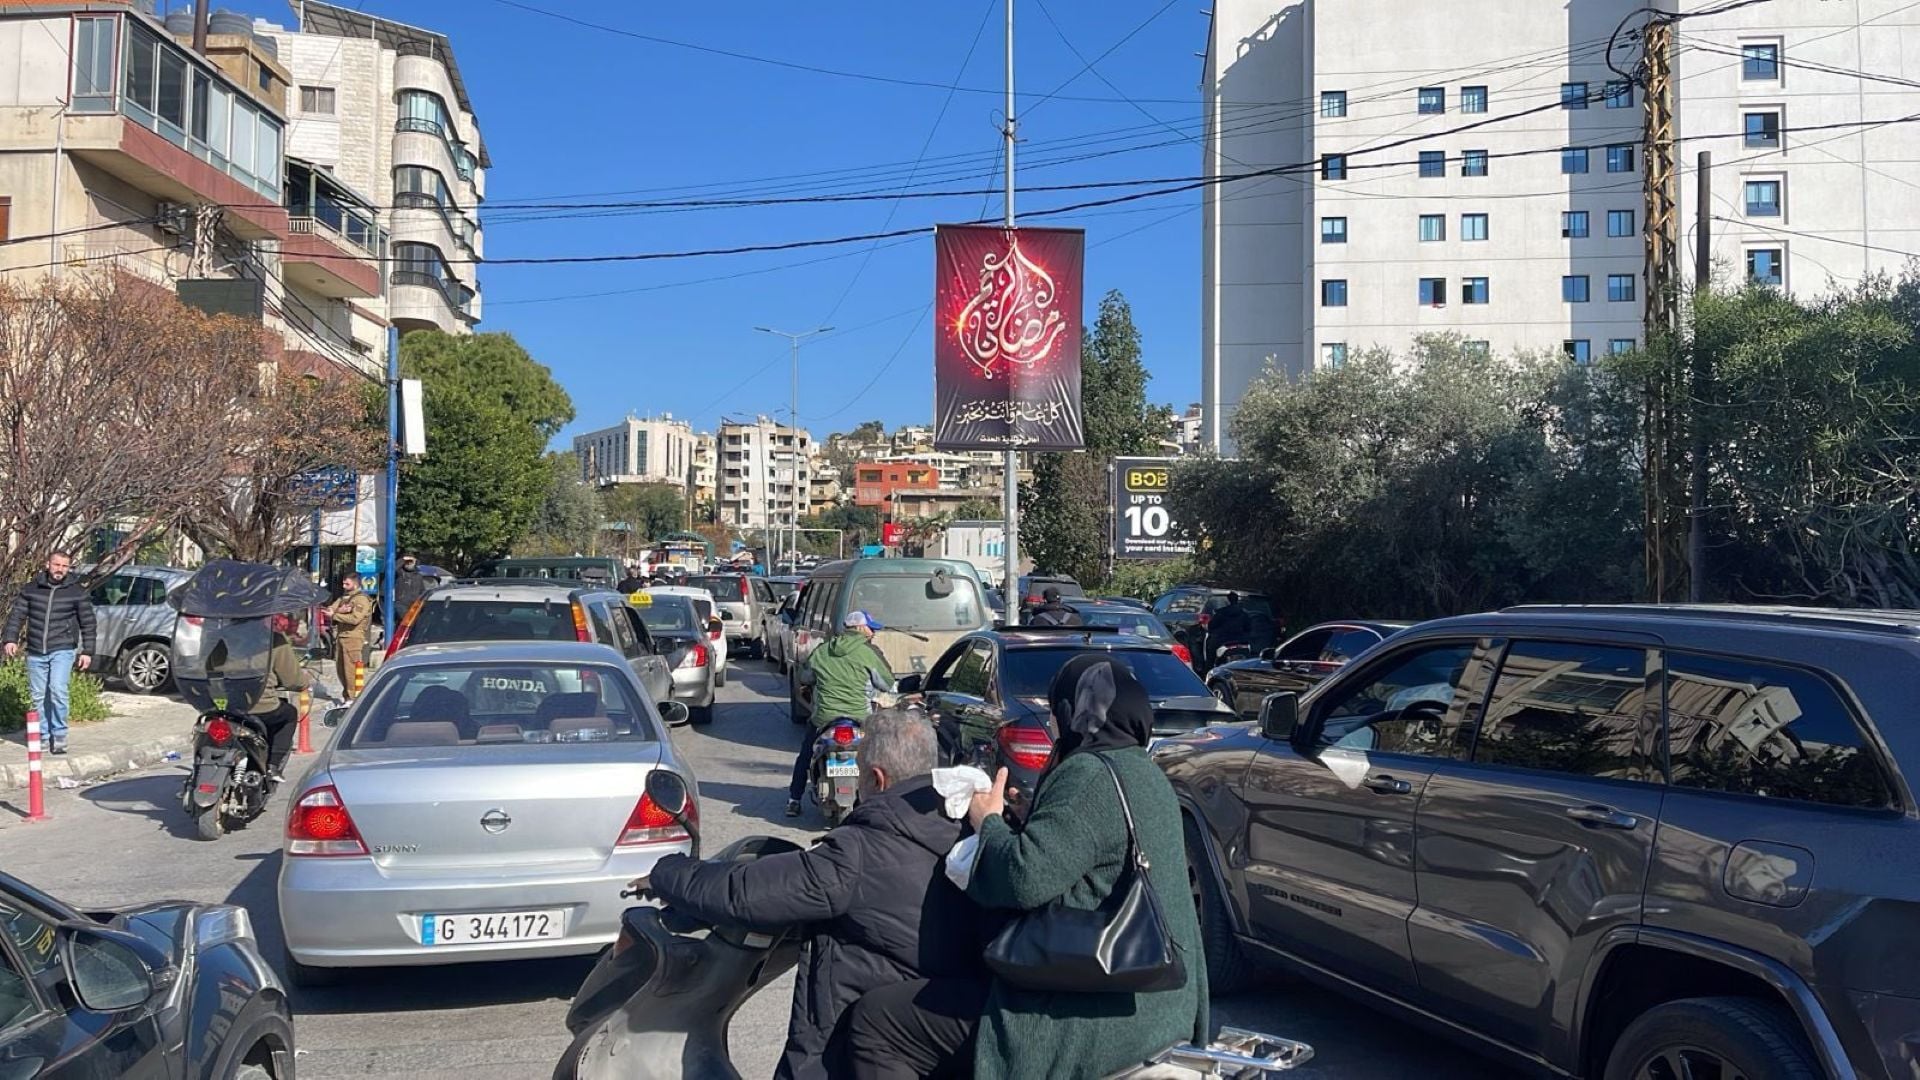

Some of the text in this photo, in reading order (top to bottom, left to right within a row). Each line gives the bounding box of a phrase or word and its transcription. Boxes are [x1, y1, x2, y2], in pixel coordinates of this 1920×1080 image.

[1130, 495, 1162, 505] UP TO
[482, 678, 547, 693] HONDA
[374, 844, 419, 853] SUNNY
[442, 919, 455, 940] G
[469, 914, 550, 939] 344172
